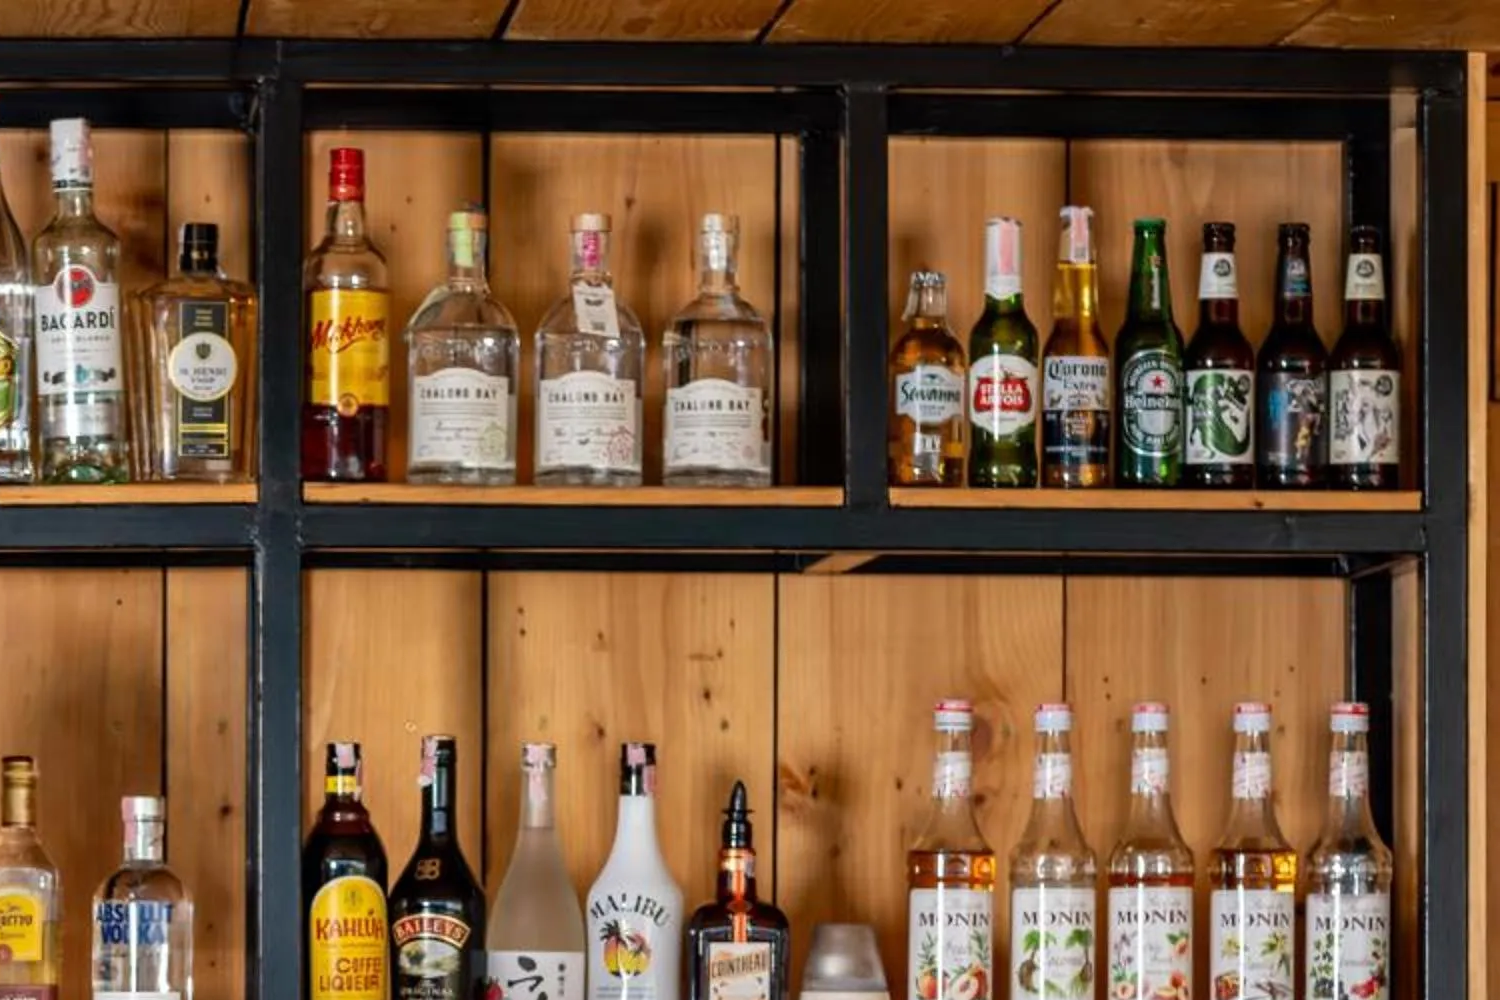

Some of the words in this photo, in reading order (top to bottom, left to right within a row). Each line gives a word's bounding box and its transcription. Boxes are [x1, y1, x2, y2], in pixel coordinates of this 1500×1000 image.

[475, 387, 499, 400] BAY
[980, 383, 1023, 396] STLLA
[604, 392, 626, 404] BAY
[728, 399, 751, 412] BAY
[980, 395, 1024, 406] AROIS
[590, 892, 671, 928] MALIBU
[1117, 910, 1189, 925] MONIN
[918, 911, 991, 928] MONIN
[1022, 910, 1093, 926] MONIN
[1220, 912, 1292, 928] MONIN
[1314, 915, 1387, 931] MONIN
[396, 914, 467, 940] BAILEYS
